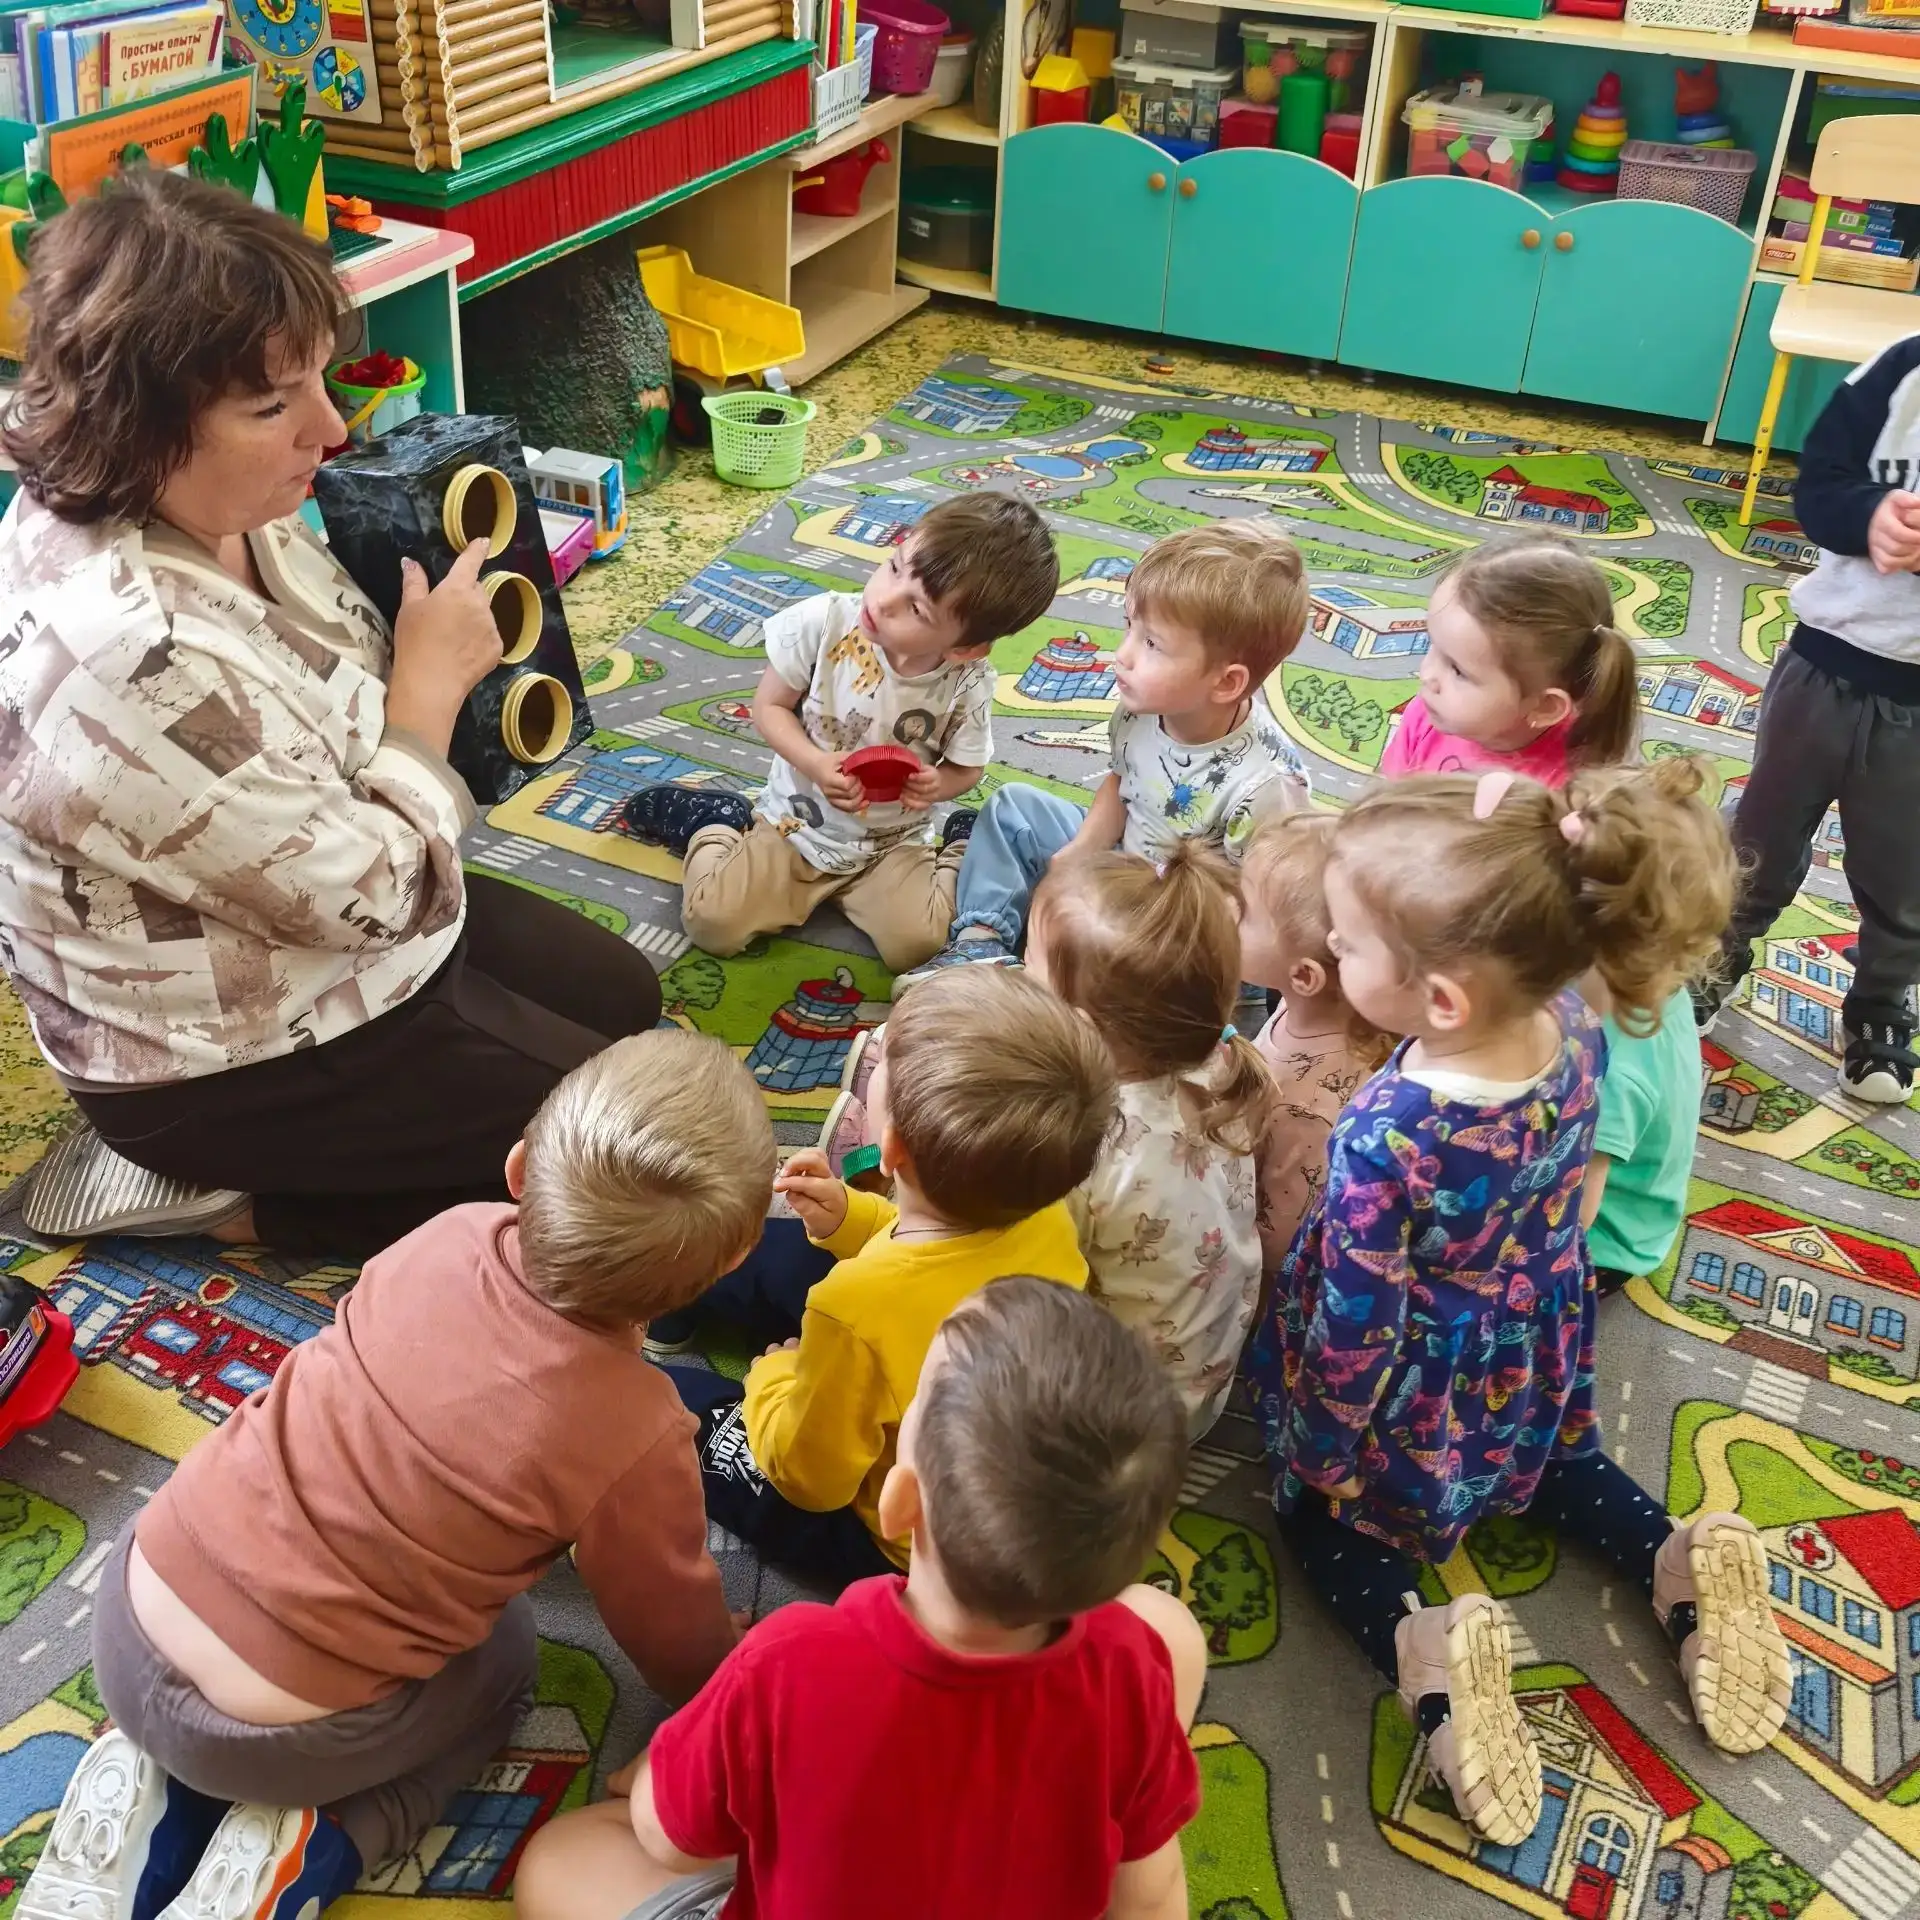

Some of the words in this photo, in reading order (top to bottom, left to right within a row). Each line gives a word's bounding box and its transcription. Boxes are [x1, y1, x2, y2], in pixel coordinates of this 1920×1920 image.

[120, 40, 165, 60] Простые
[167, 33, 202, 49] опыты
[122, 70, 127, 82] с
[130, 47, 194, 80] БУМАГОЙ
[1086, 588, 1126, 605] BU
[712, 1425, 728, 1447] CLAWS
[711, 1426, 747, 1475] WOLF
